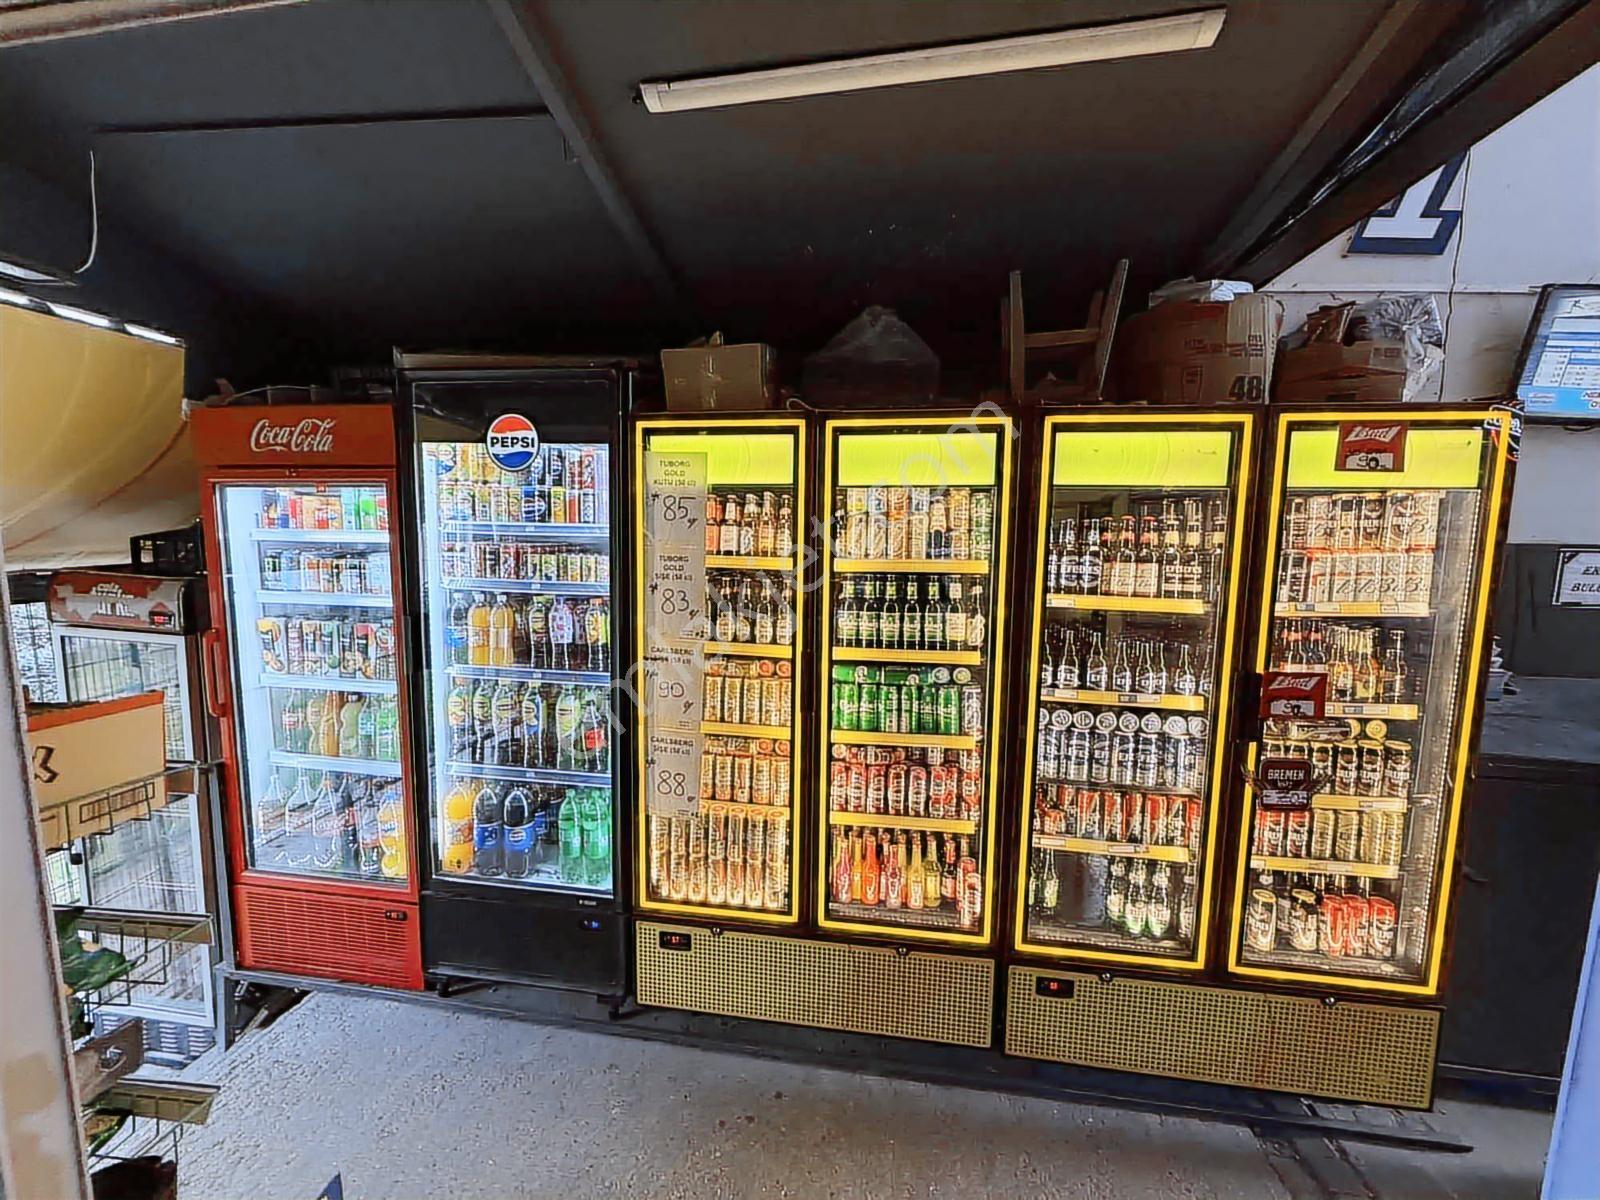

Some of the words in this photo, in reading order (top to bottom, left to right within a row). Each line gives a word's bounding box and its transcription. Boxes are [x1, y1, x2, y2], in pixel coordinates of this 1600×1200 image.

[250, 418, 337, 452] Coca-Cola
[490, 436, 535, 448] PEPSI
[662, 494, 697, 522] 85
[661, 588, 690, 615] 83
[657, 770, 686, 797] 88
